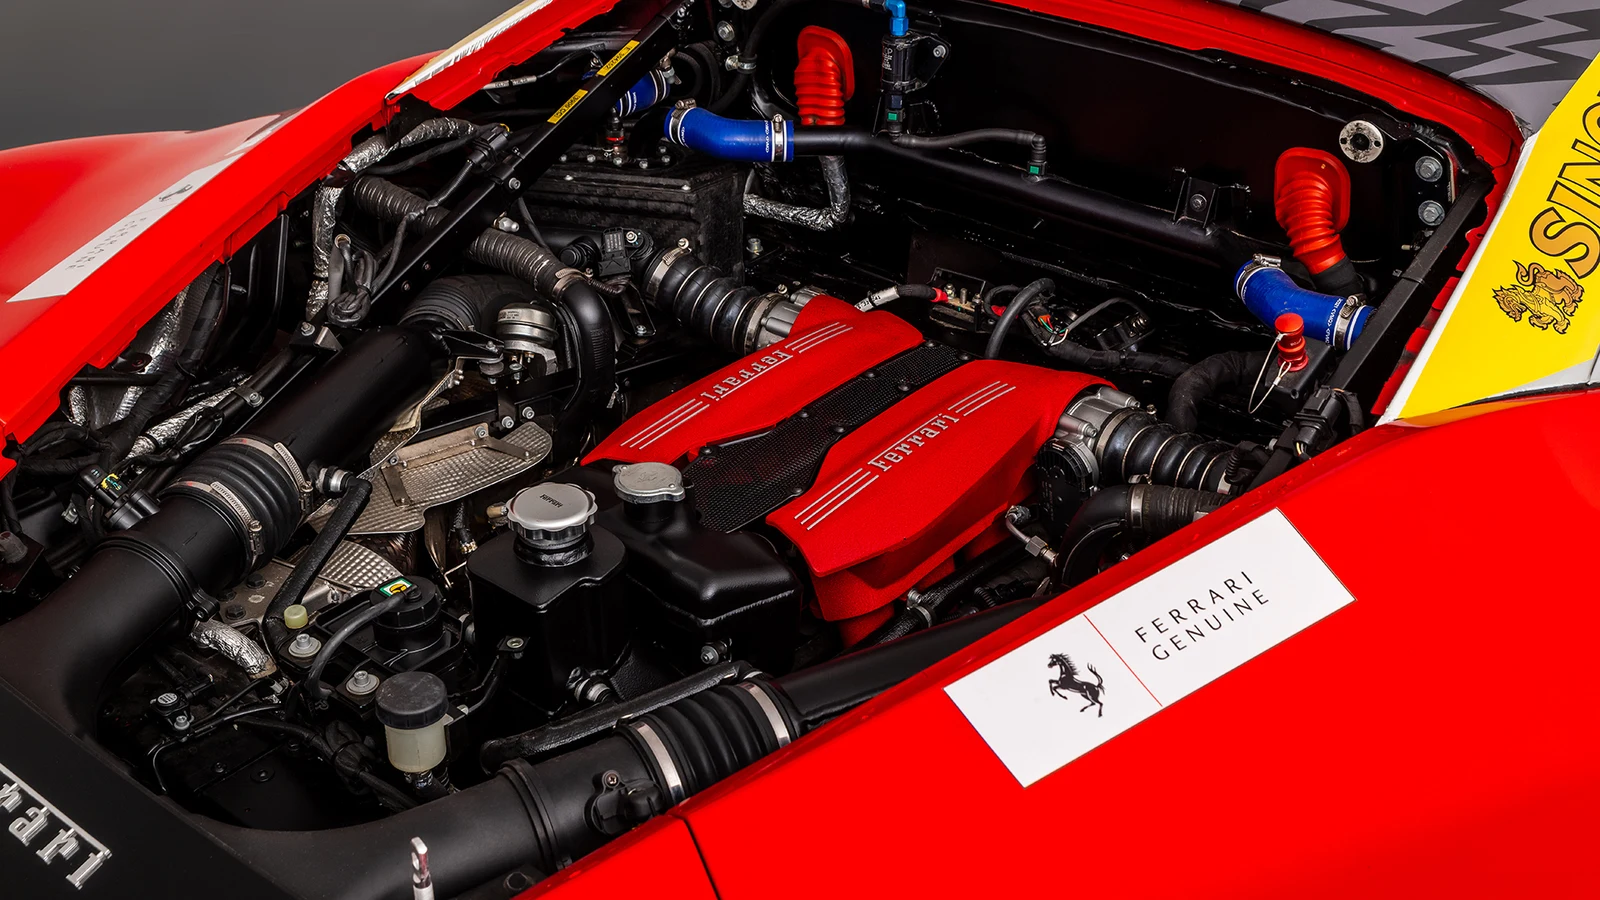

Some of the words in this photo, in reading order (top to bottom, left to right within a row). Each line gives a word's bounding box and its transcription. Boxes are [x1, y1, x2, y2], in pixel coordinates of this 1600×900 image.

[701, 348, 794, 402] Ferrari
[866, 412, 961, 473] Ferrari
[1134, 571, 1254, 644] FERRARI
[1151, 588, 1270, 661] GENUINE
